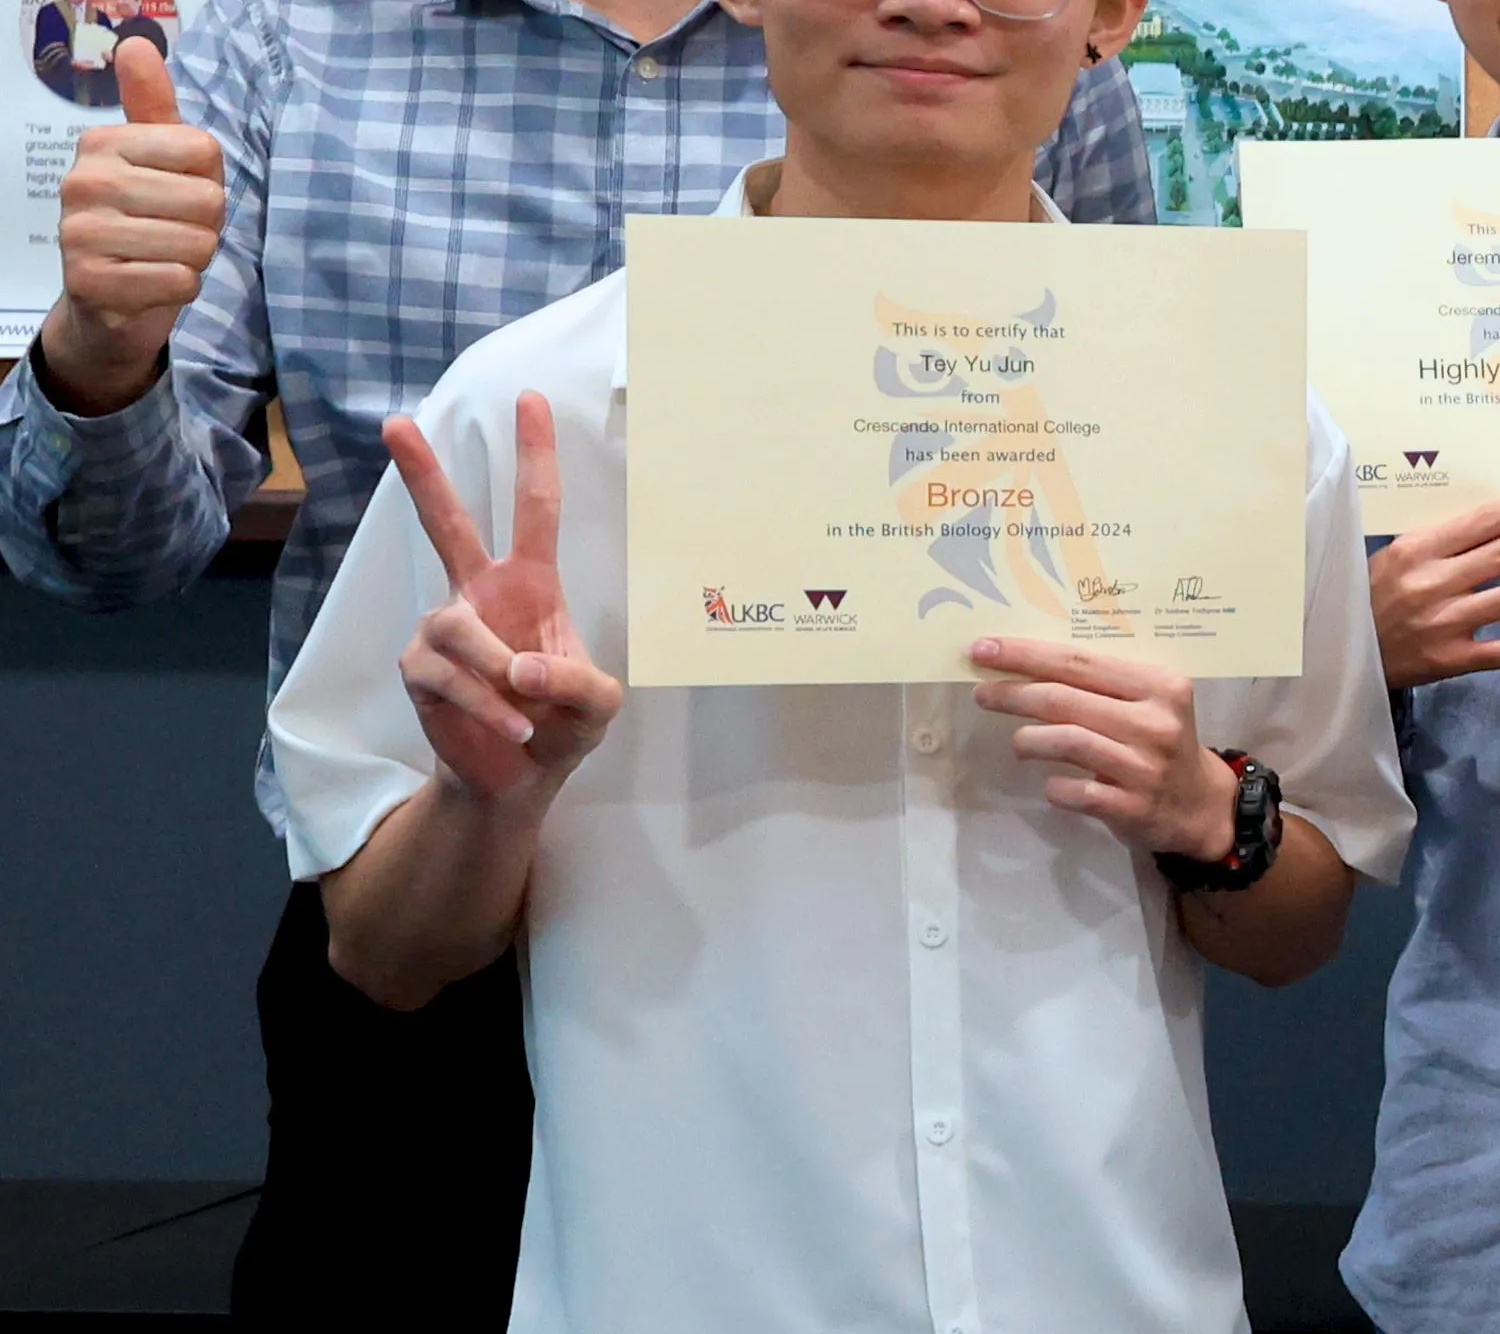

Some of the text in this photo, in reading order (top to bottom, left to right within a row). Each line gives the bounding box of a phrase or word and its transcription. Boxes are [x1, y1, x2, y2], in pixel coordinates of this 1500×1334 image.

[892, 322, 1065, 342] This is to certify that
[920, 354, 1035, 377] Tey Yu Jun
[1419, 358, 1500, 385] Highly
[961, 389, 1000, 404] from
[853, 418, 1101, 437] Crescendo International College
[905, 446, 1056, 463] has been awarded
[927, 482, 1034, 508] Bronze
[826, 522, 1132, 541] in the British Biology Olympiad 2024
[793, 613, 858, 626] WARWICK
